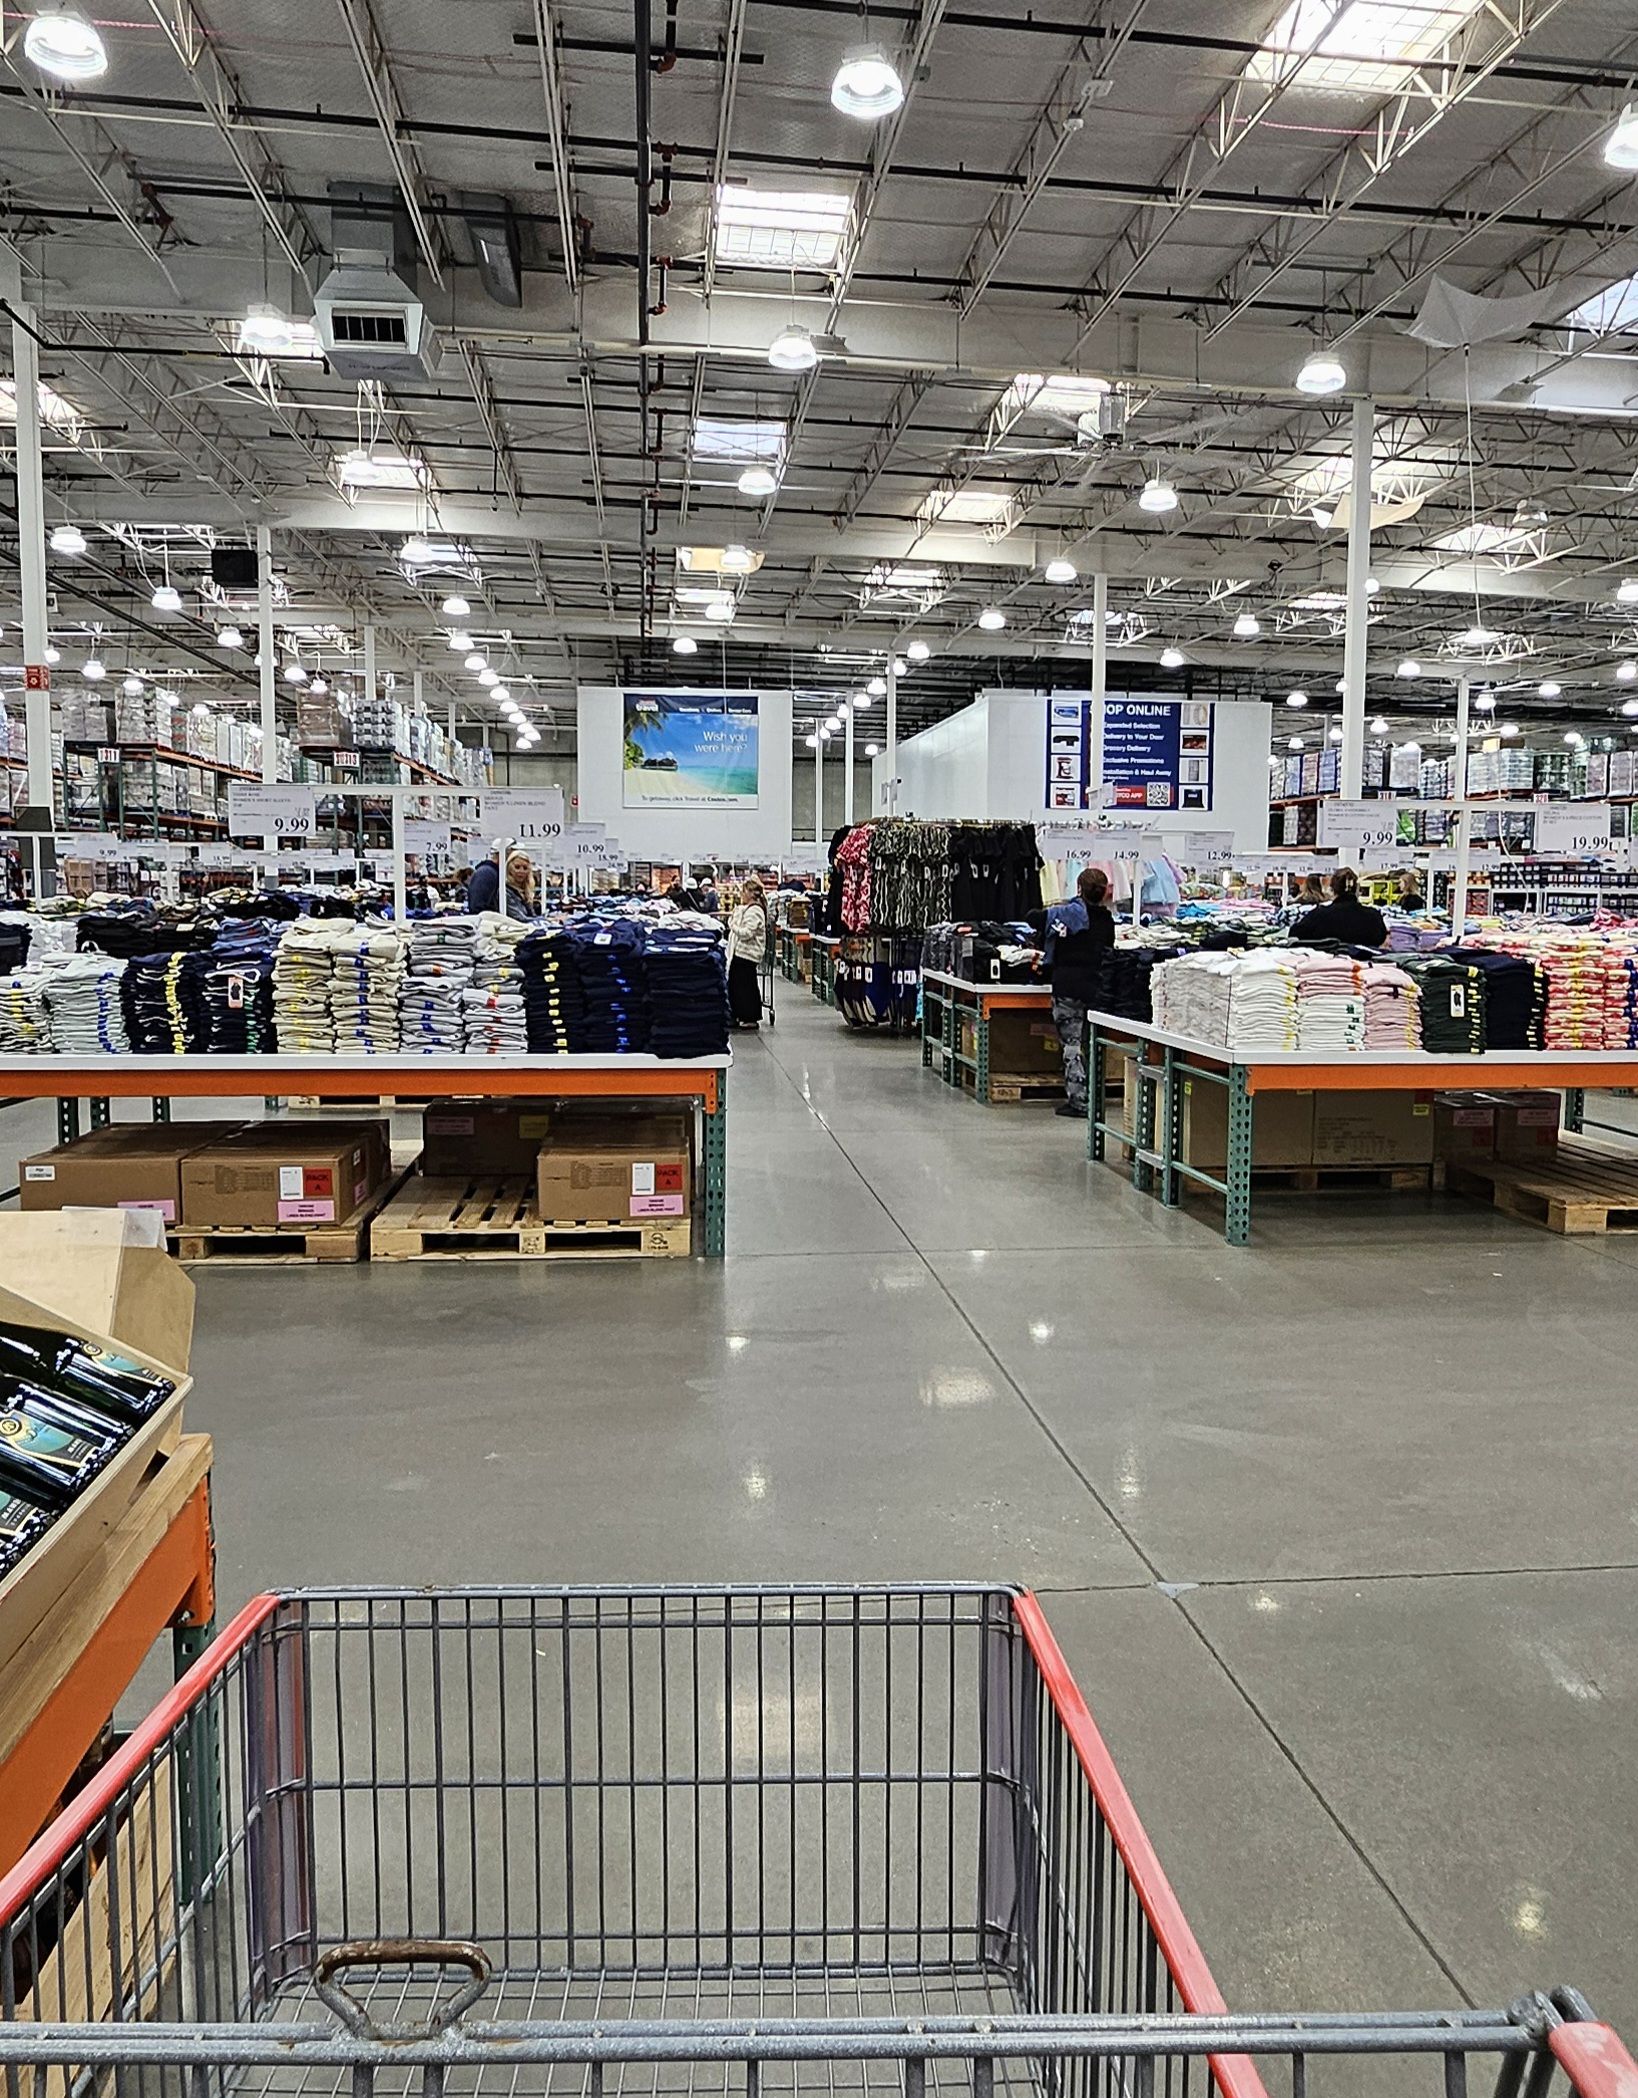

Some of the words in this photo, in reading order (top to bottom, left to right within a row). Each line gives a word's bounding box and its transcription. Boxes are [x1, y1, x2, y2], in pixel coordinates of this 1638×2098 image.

[1126, 704, 1172, 716] ONLINE
[703, 731, 727, 742] Wish
[729, 733, 748, 744] you
[694, 744, 720, 752] were
[721, 743, 748, 752] here?
[274, 818, 309, 832] 9.99
[520, 823, 560, 838] 11.99
[1362, 831, 1393, 846] 9.99
[1572, 836, 1608, 850] 19.99
[426, 842, 448, 852] 7.99
[578, 844, 604, 854] 10.99
[1066, 850, 1092, 860] 16.99
[1114, 850, 1140, 860] 14.99
[1207, 851, 1232, 860] 12.99
